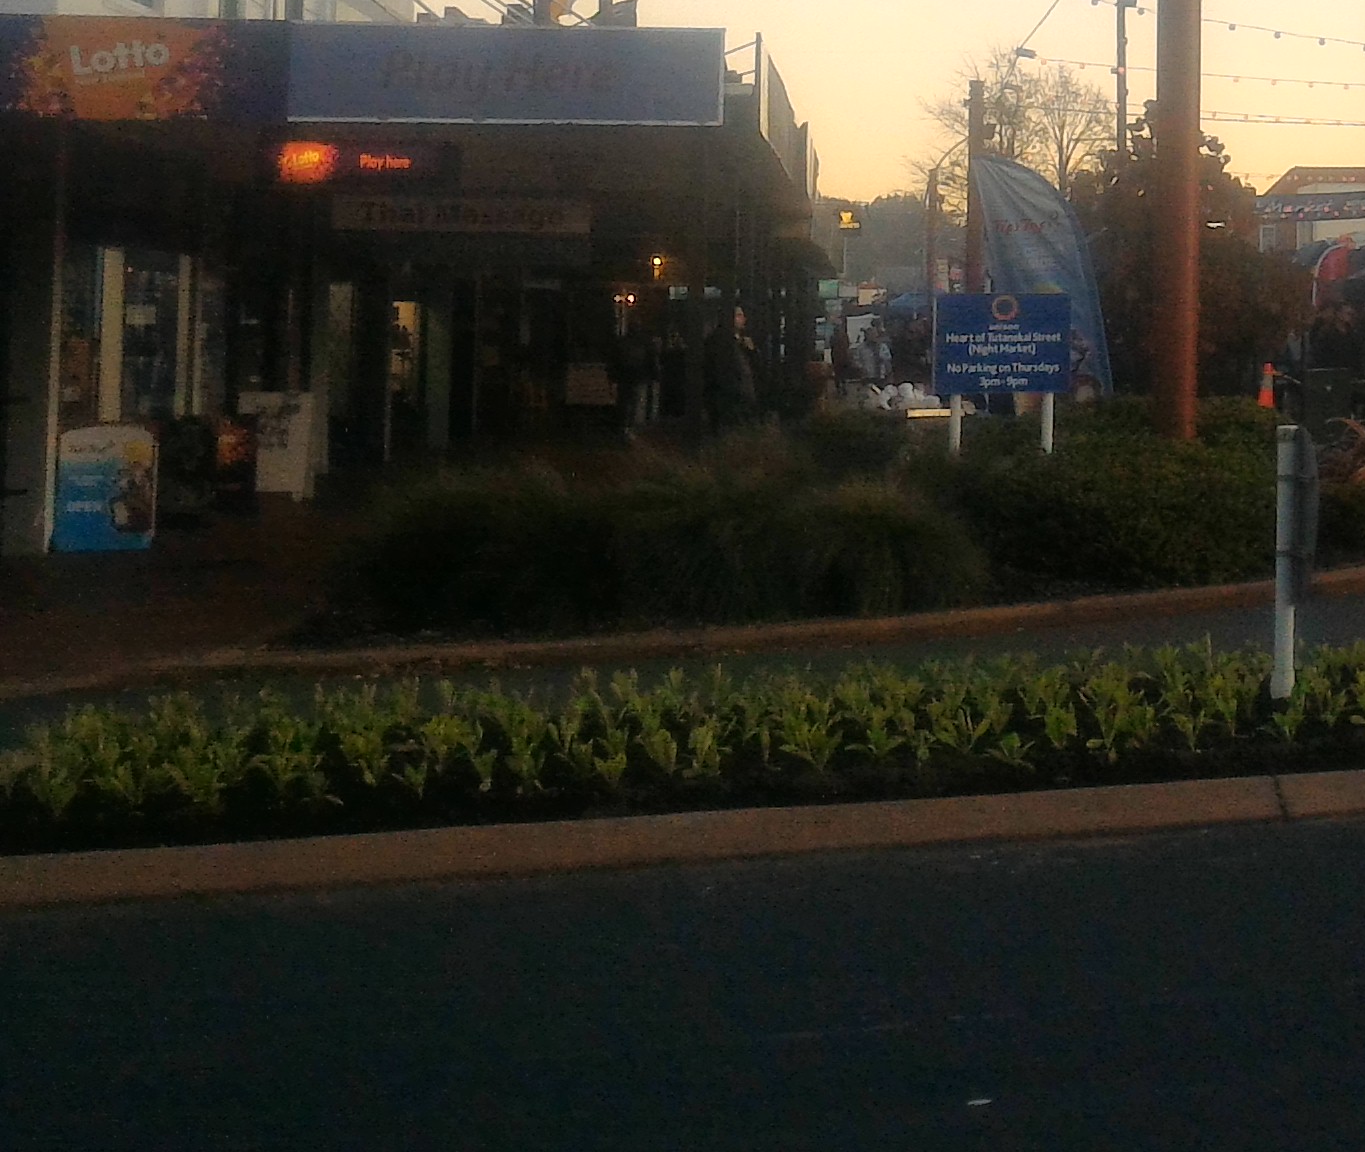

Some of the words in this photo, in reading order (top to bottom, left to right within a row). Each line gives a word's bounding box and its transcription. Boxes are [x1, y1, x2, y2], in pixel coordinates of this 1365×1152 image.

[70, 39, 170, 76] Lotto
[360, 153, 385, 171] Play
[946, 332, 974, 343] Heart
[975, 332, 986, 343] of
[1033, 332, 1062, 343] Street
[968, 344, 998, 356] (Night
[946, 363, 961, 373] No
[962, 363, 998, 375] Parking
[999, 364, 1011, 373] on
[1012, 362, 1060, 375] Thursdays
[979, 377, 1001, 389] 3pm
[1006, 377, 1028, 389] 9pm
